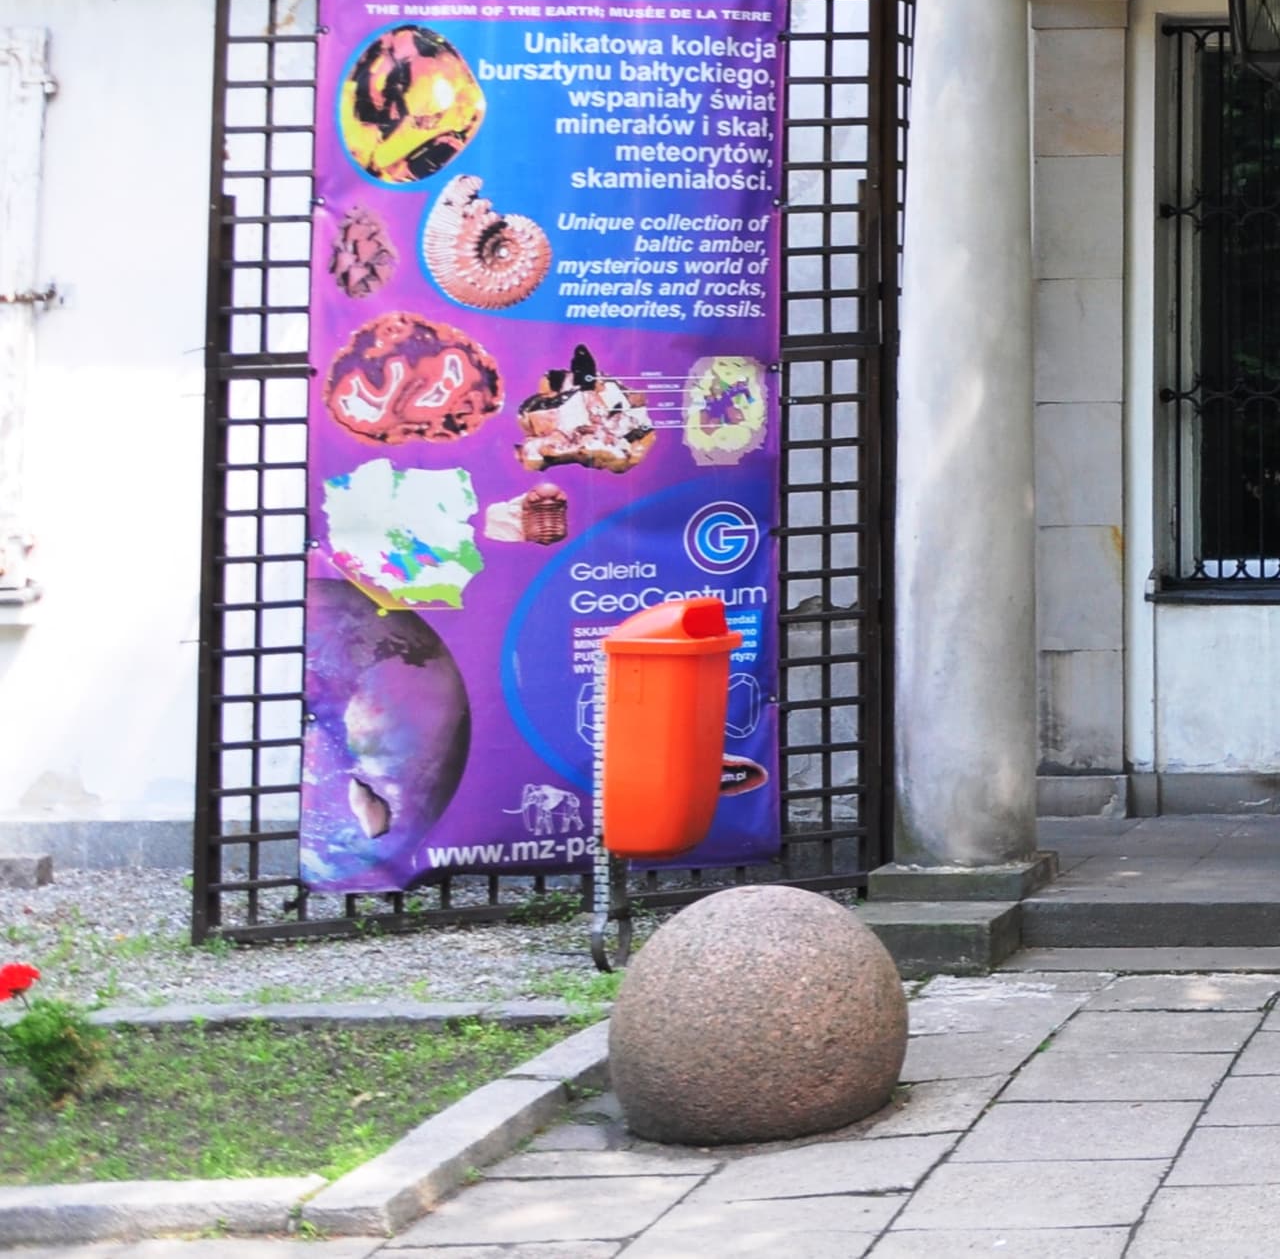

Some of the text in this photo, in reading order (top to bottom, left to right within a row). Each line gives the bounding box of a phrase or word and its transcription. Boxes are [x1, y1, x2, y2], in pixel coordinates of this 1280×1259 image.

[365, 4, 399, 15] THE
[404, 4, 477, 16] MUSEUM
[482, 6, 505, 16] OF
[509, 6, 541, 16] THE
[609, 4, 665, 19] MUSÉE
[670, 8, 691, 19] DE
[697, 9, 717, 20] LA
[721, 10, 772, 22] TERRE
[524, 32, 776, 63] Unikatowa kolekcja
[478, 59, 776, 89] bursztynu bałtyckiego,
[568, 88, 776, 114] wspaniały świat
[555, 113, 774, 141] minerałów i skał,
[615, 143, 773, 168] meteorytów,
[571, 167, 773, 191] skamieniałości.
[557, 213, 770, 234] Unique collection of
[634, 235, 766, 256] baltic amber,
[557, 257, 769, 278] mysterious world of
[559, 278, 766, 299] minerals and rocks,
[565, 300, 766, 320] meteorites, fossils.
[570, 561, 657, 581] Galeria
[427, 836, 597, 868] www.mz-pa
